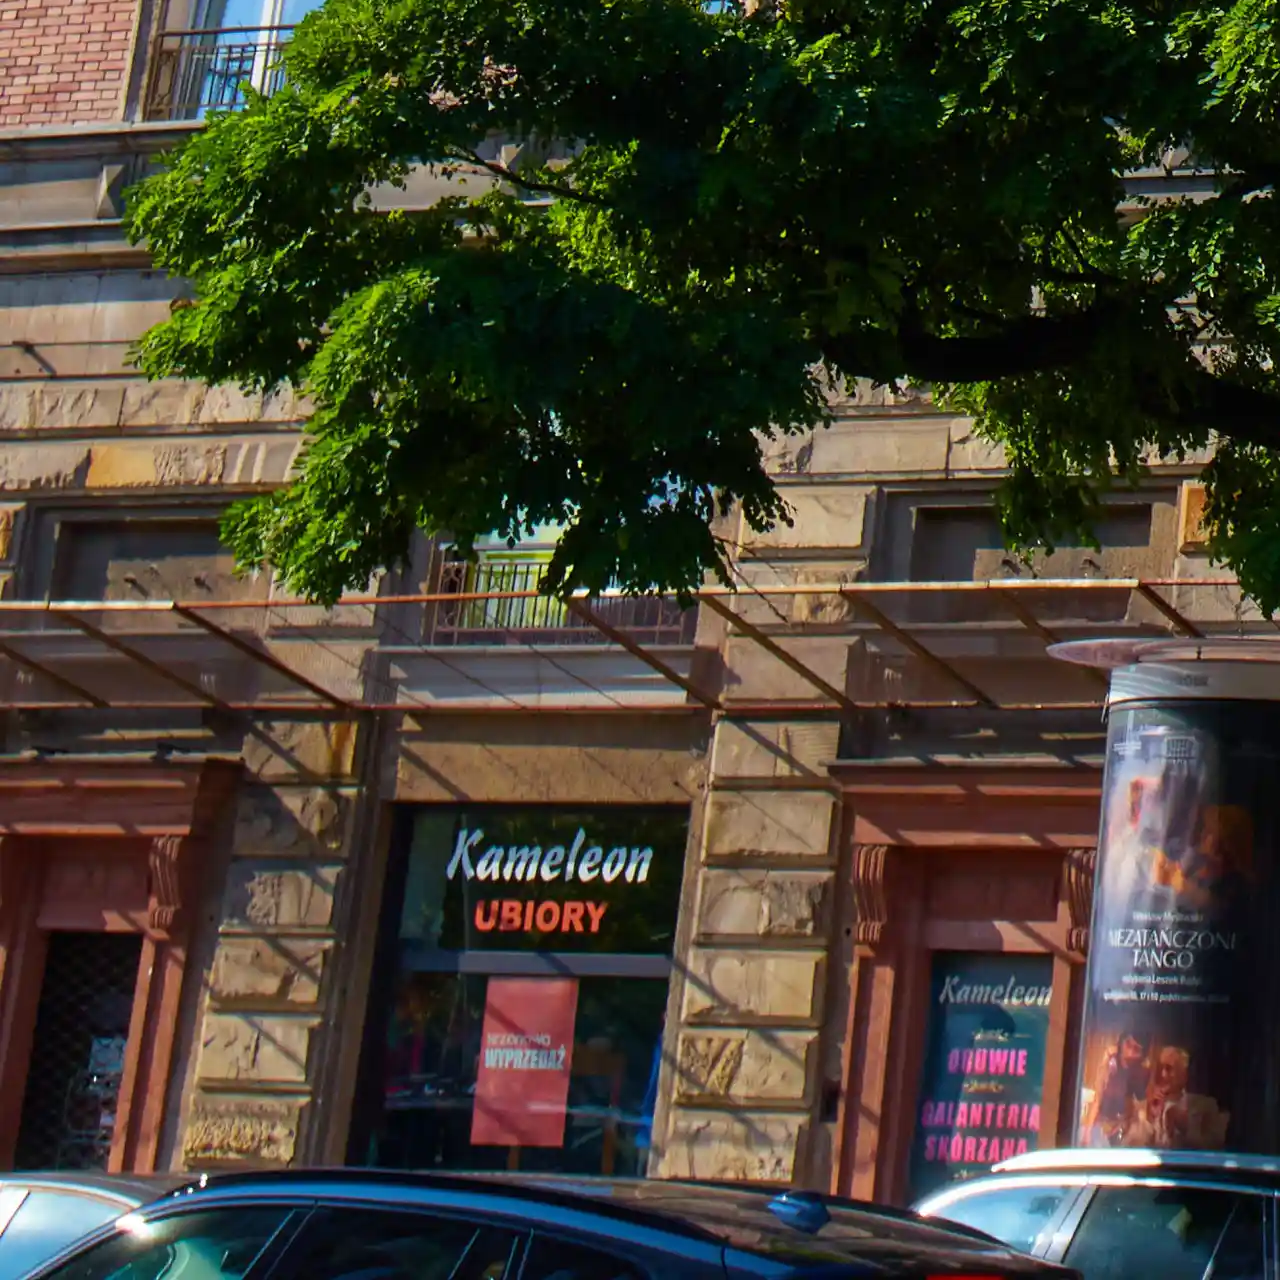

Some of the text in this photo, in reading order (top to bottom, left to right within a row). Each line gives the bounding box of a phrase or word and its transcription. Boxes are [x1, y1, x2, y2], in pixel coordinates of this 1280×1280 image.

[446, 826, 654, 884] Kameleon
[473, 899, 608, 933] UBIORY
[1132, 948, 1194, 969] TANGO
[938, 974, 1052, 1007] Kameleon
[485, 1044, 567, 1071] WYPRZEDAŻ
[947, 1047, 1028, 1076] OBUWIE
[921, 1101, 1041, 1133] GALANTERIA
